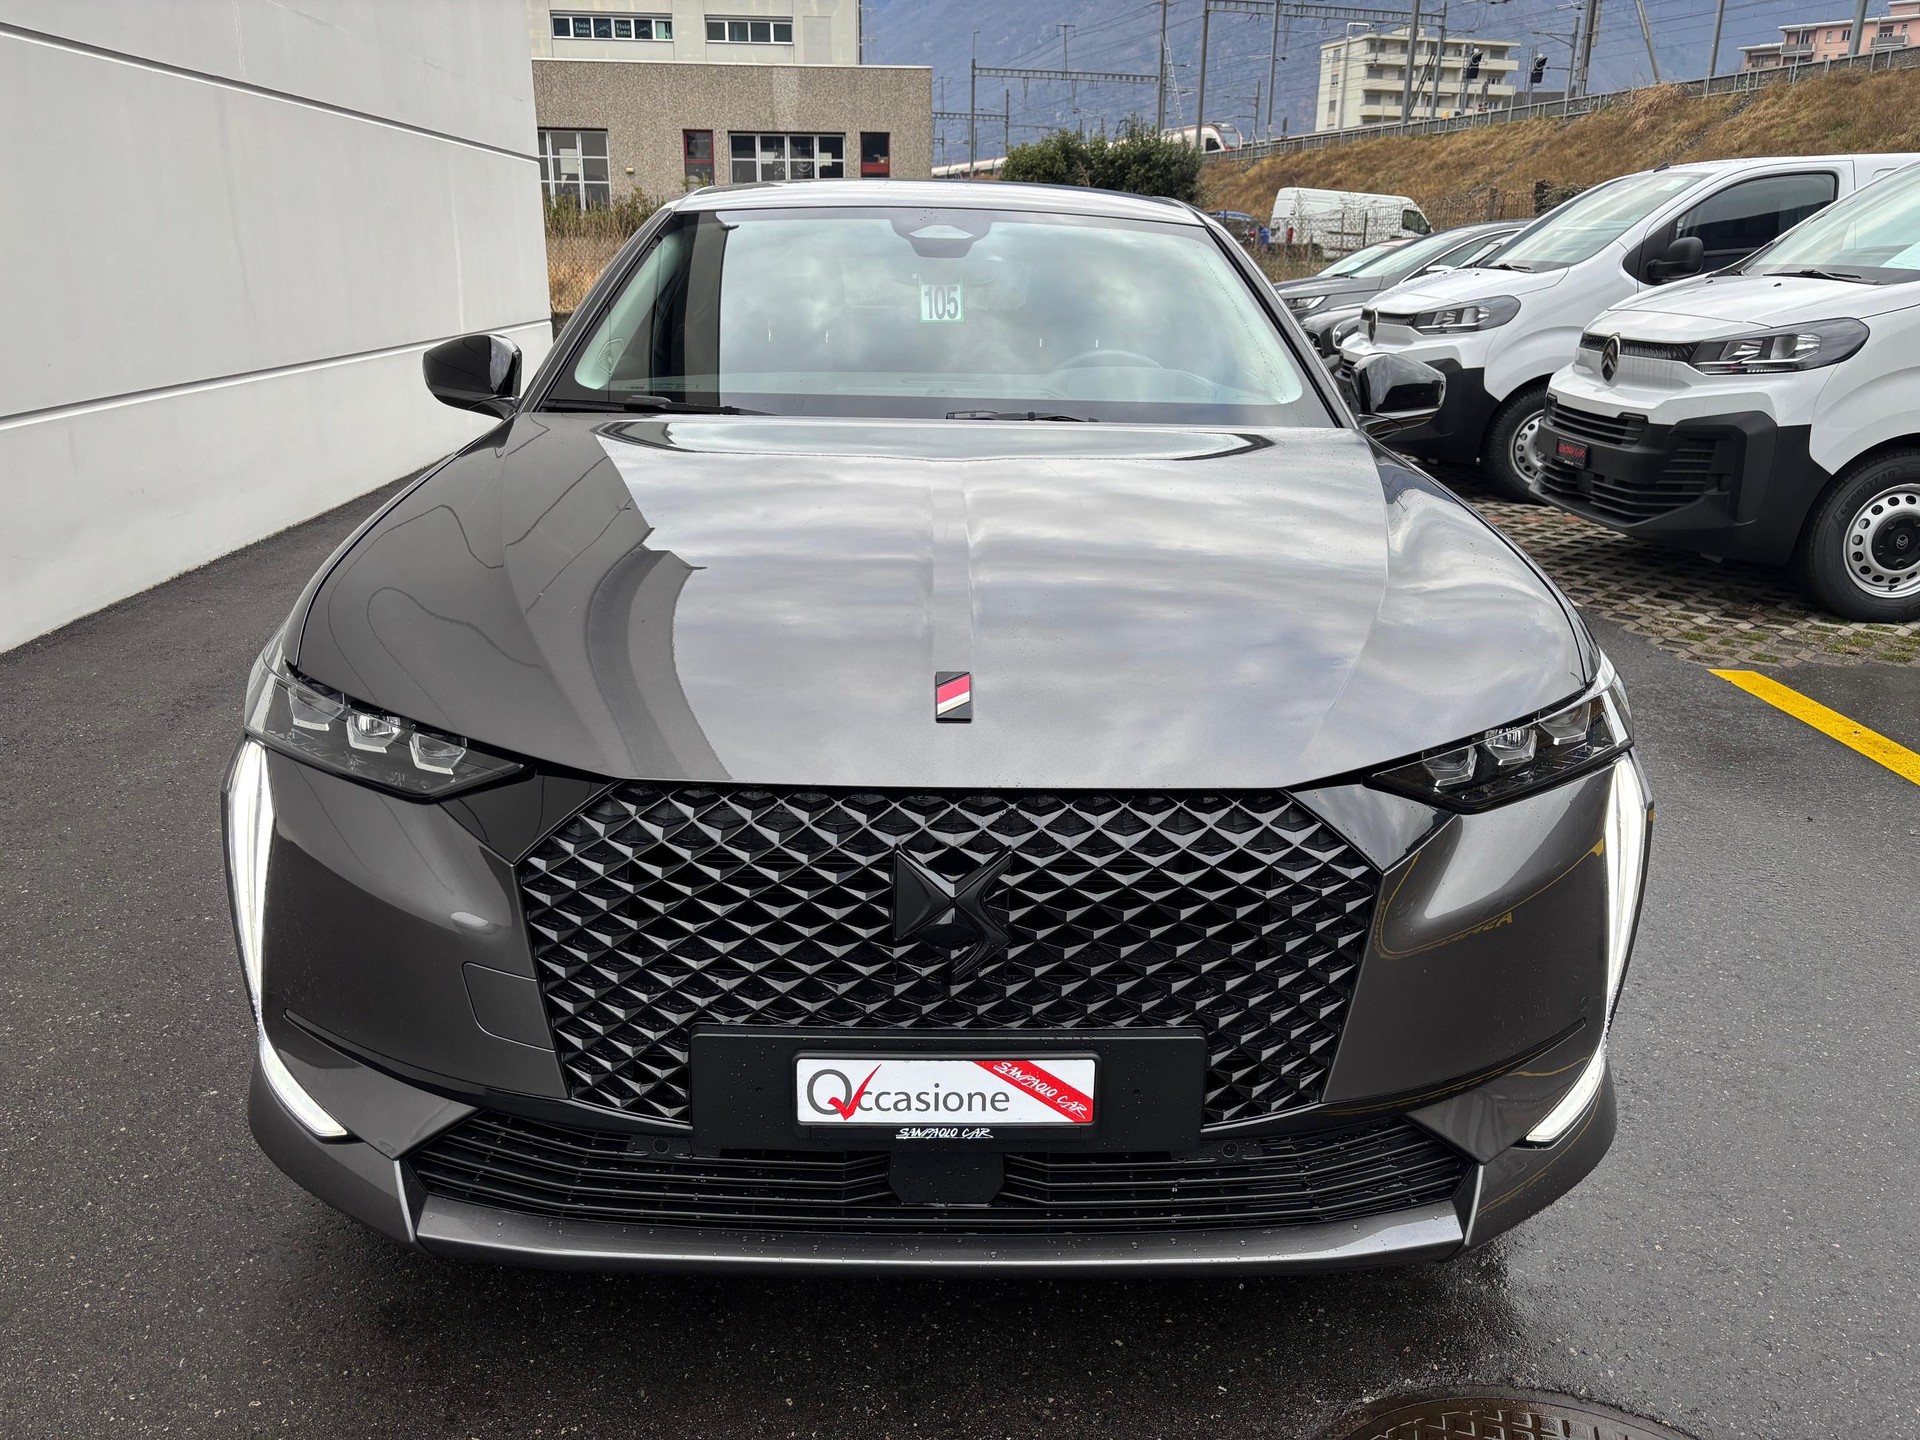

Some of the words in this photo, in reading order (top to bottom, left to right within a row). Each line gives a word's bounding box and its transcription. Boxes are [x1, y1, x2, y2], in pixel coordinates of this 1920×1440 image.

[924, 285, 959, 320] 105
[993, 1061, 1058, 1098] SANPAOLO
[1057, 1095, 1087, 1119] CAR
[896, 1127, 958, 1139] SANPAOLO
[961, 1127, 994, 1139] CAR
